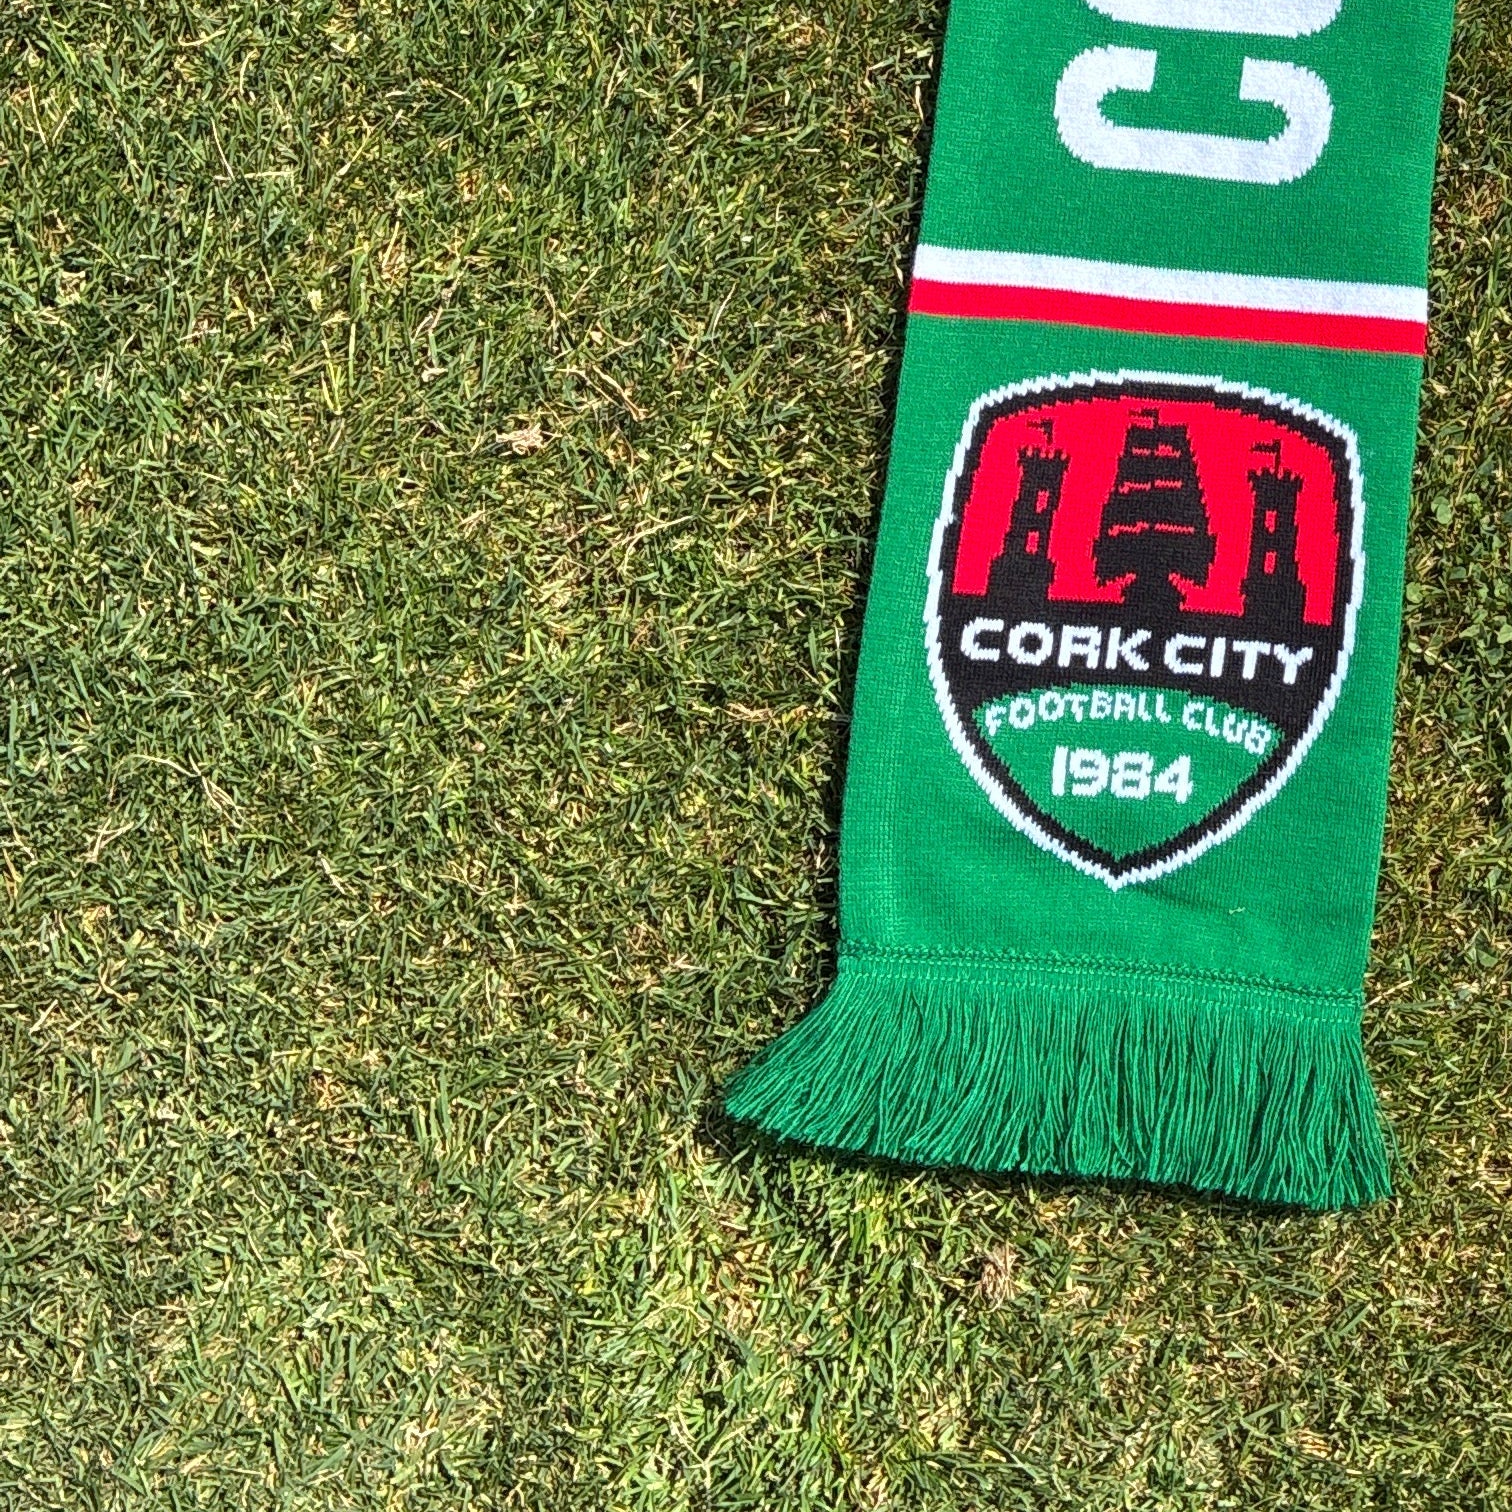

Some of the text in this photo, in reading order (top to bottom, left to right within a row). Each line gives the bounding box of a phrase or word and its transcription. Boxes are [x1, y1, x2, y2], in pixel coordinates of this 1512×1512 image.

[960, 616, 1314, 684] CORK CITY
[983, 690, 1273, 756] FOOTBALL CLUB
[1050, 745, 1195, 804] 1984
